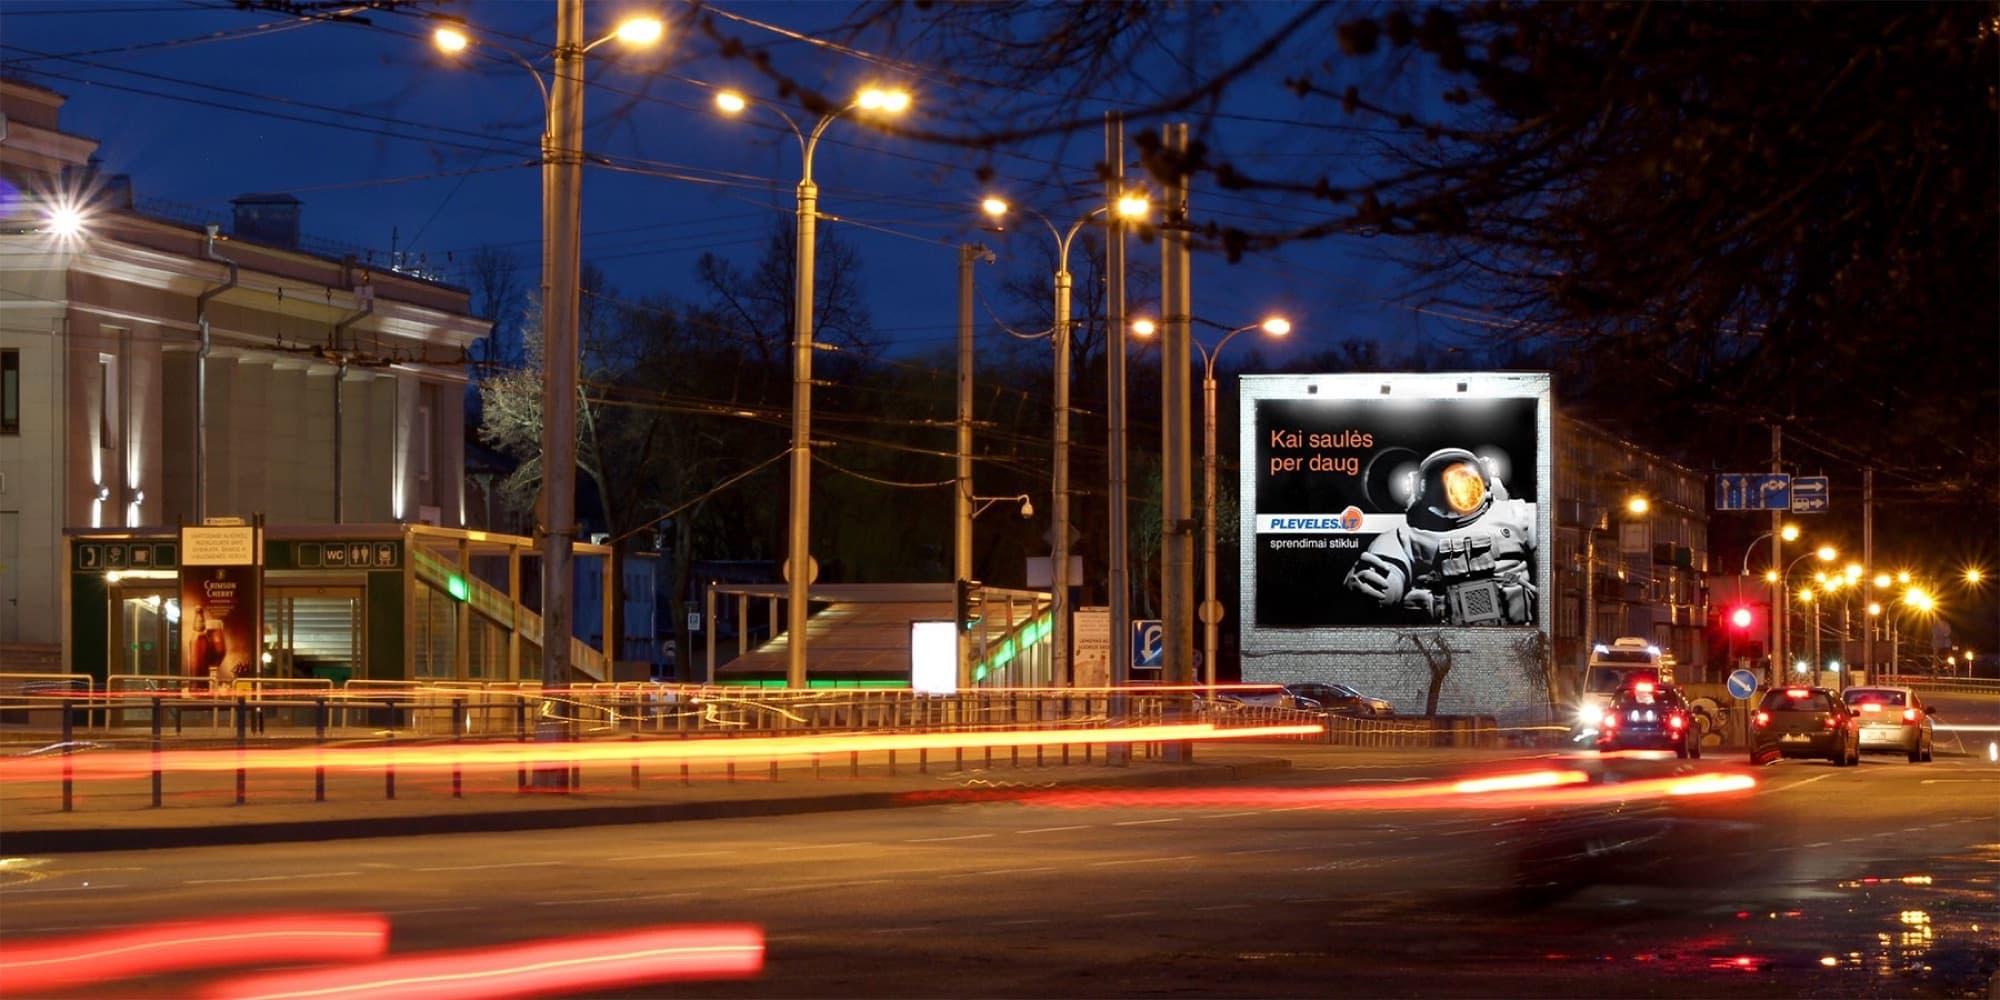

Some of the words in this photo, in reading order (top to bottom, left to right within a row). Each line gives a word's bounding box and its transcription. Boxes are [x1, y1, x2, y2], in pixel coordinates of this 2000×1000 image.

[1271, 430, 1302, 448] Kai
[1309, 430, 1373, 448] saulės
[1271, 457, 1303, 476] per
[1309, 453, 1358, 476] daug
[1270, 518, 1358, 529] PLEVELES.LT
[1270, 538, 1327, 550] sprendimai
[1329, 538, 1359, 549] stiklui
[327, 550, 344, 560] WC
